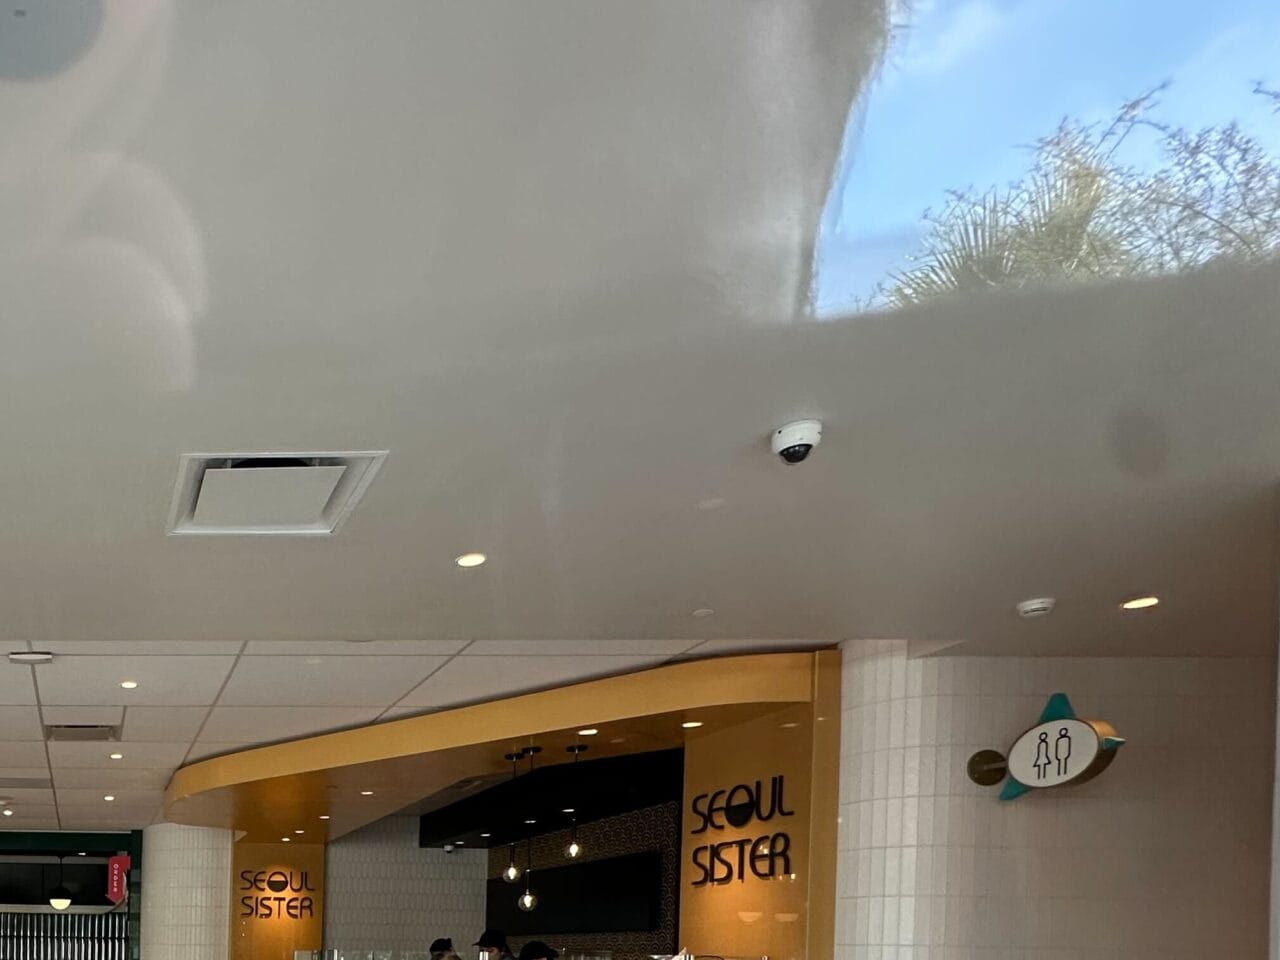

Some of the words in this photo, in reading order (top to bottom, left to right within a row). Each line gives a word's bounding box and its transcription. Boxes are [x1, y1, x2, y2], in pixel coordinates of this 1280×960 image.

[691, 775, 794, 834] SEOUL
[691, 832, 791, 887] SISTER
[240, 870, 316, 893] SEOUL
[240, 896, 314, 919] SISTER
